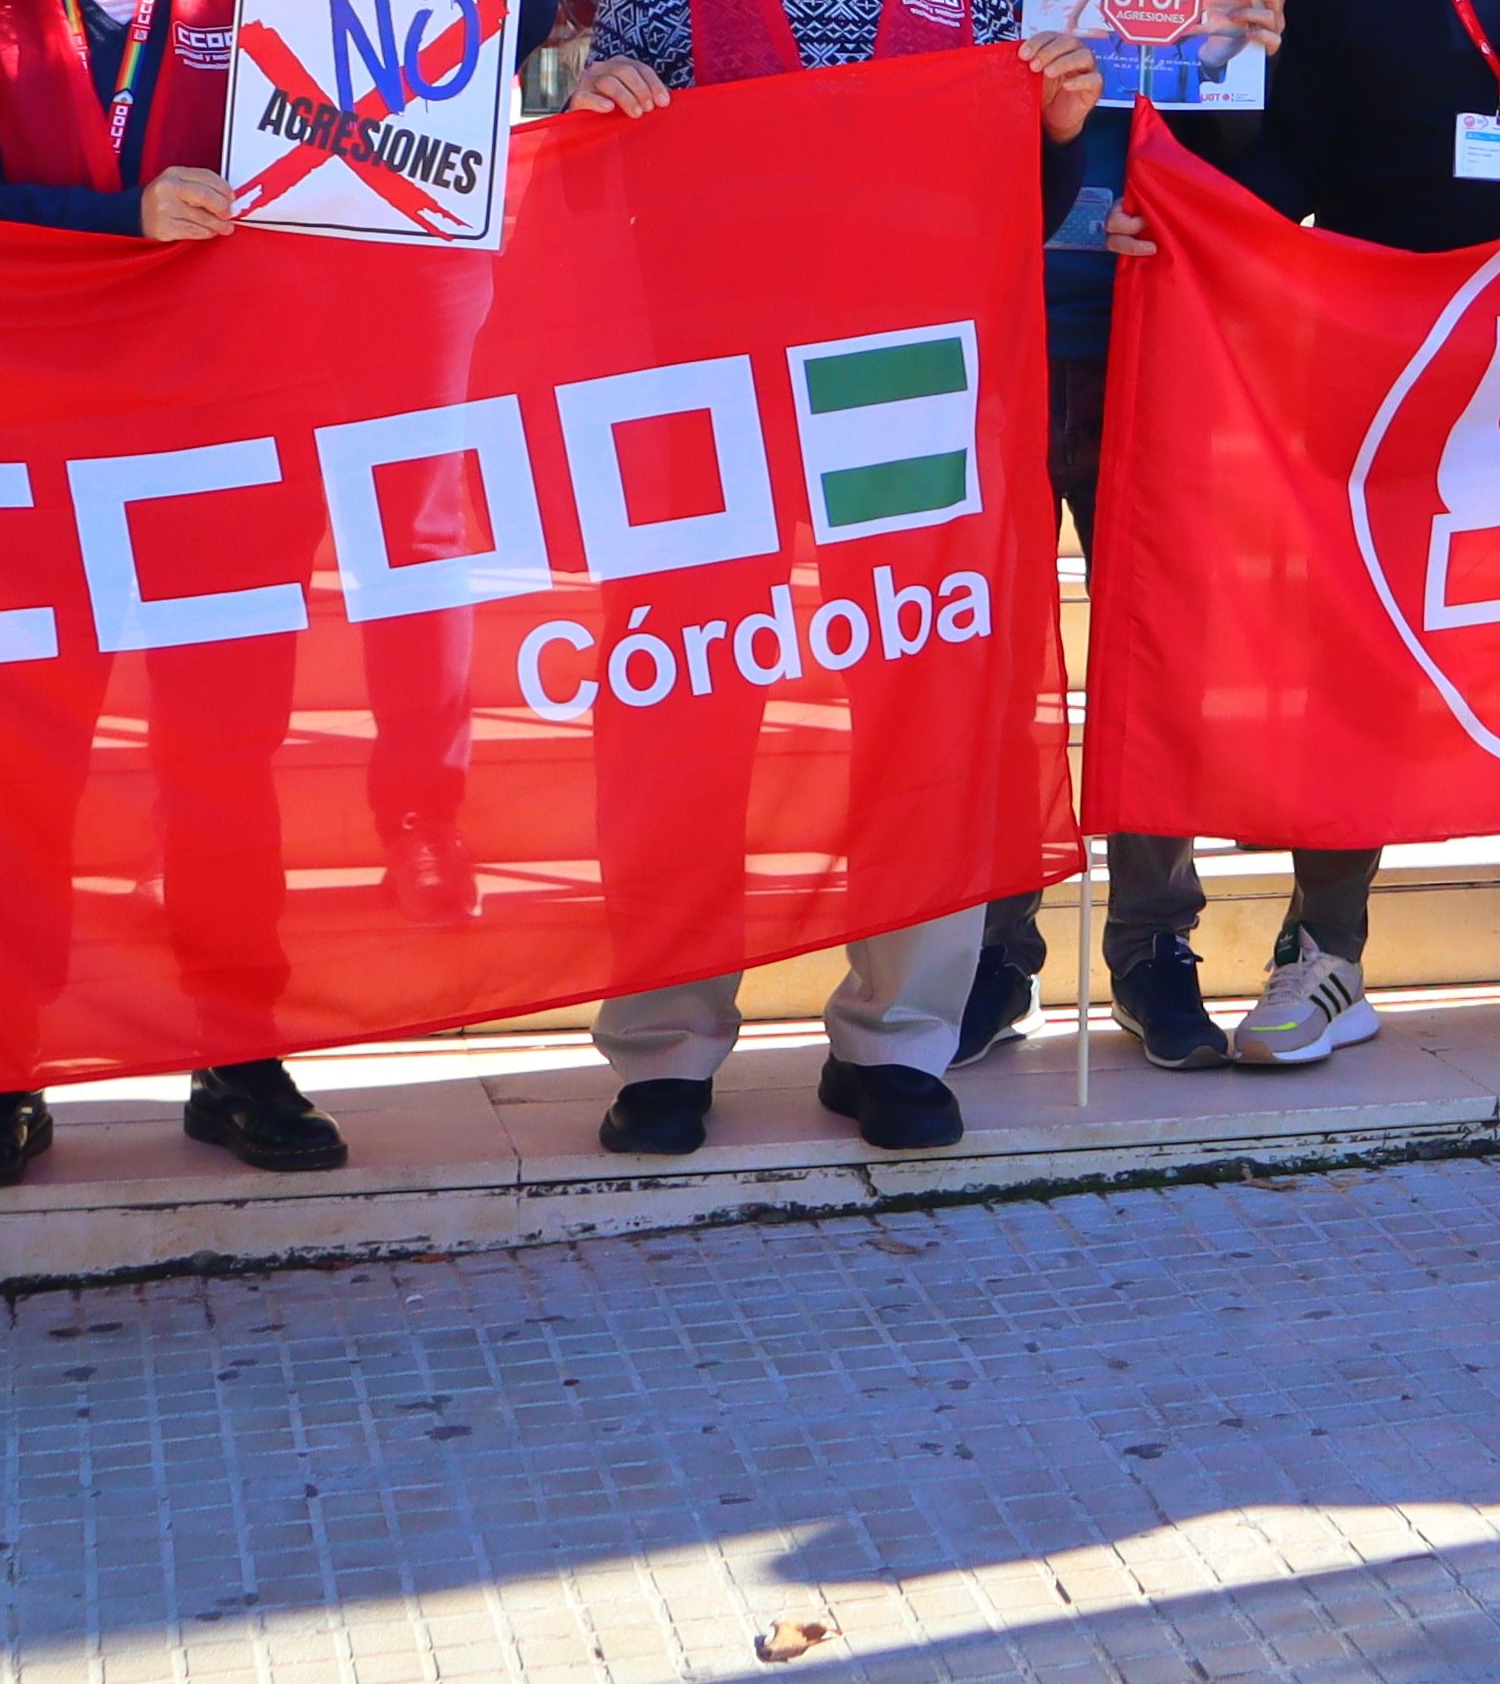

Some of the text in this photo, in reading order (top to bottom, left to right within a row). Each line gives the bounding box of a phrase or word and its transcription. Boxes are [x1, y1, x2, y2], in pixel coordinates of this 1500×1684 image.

[1116, 9, 1186, 24] AGRESIONES
[257, 88, 483, 194] AGRESIONES
[516, 566, 993, 722] Córdoba
